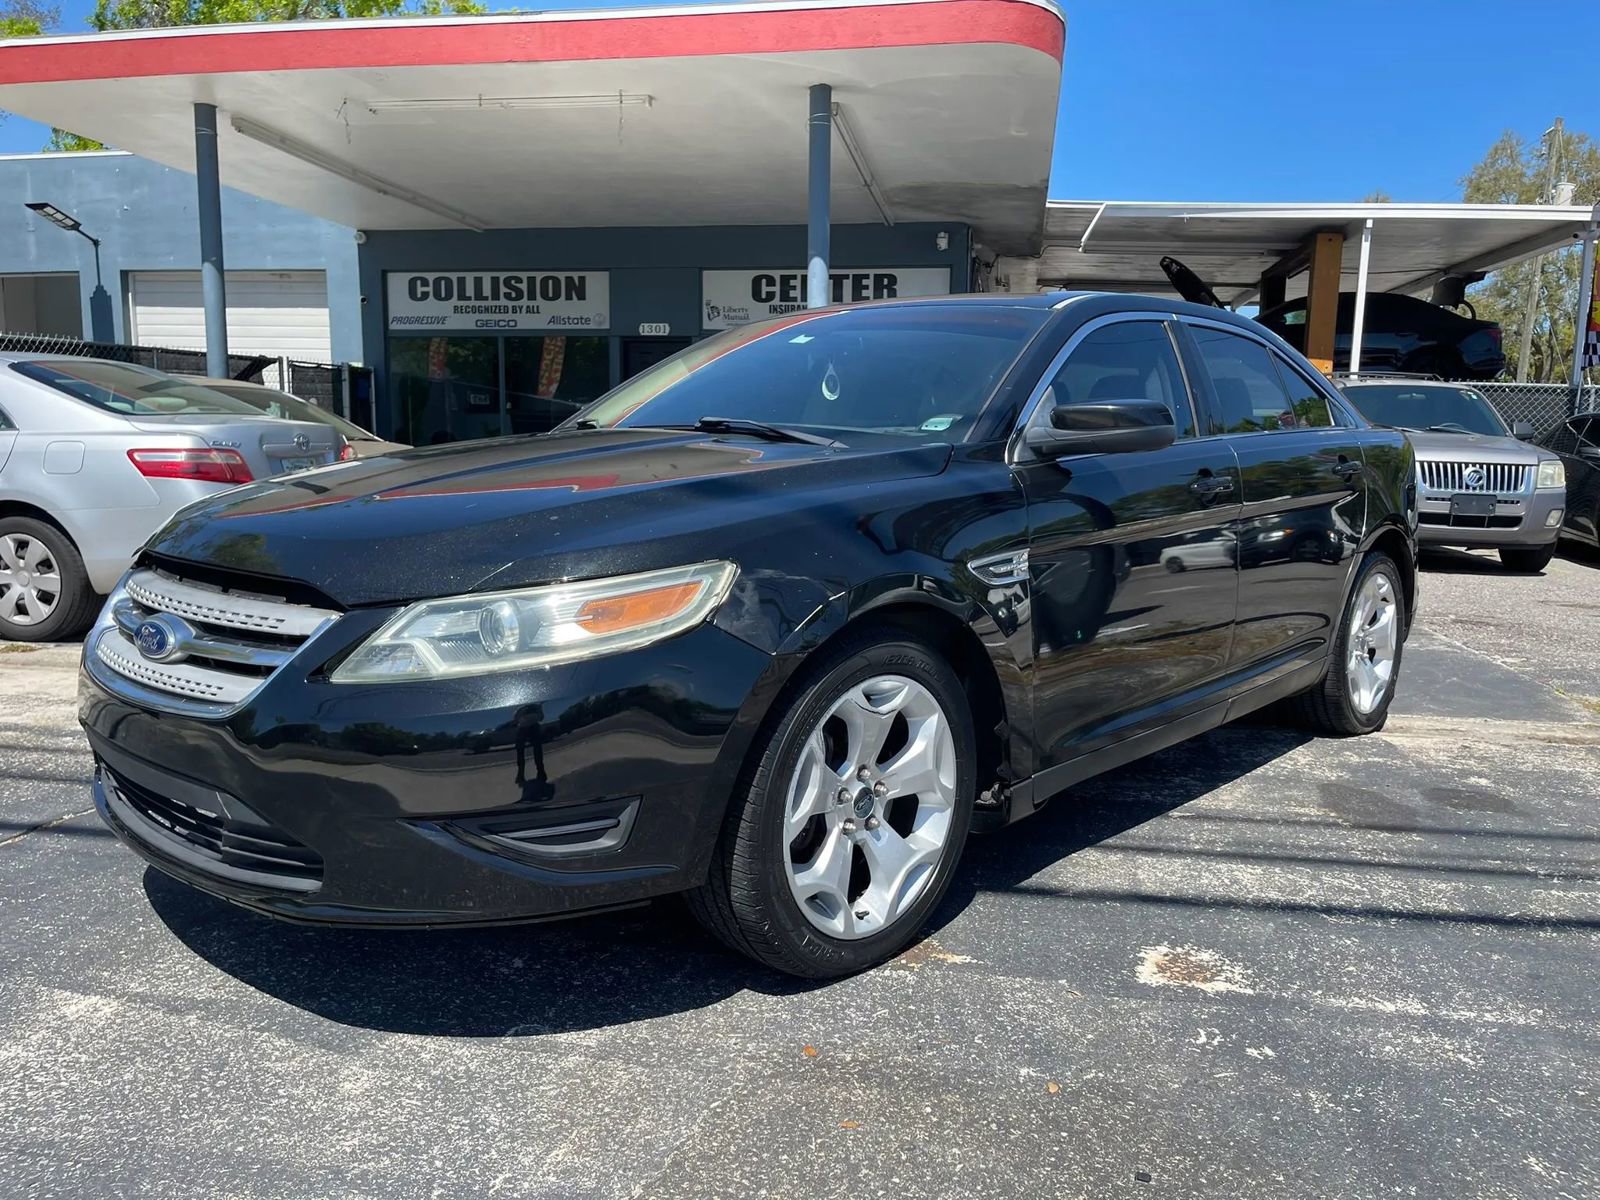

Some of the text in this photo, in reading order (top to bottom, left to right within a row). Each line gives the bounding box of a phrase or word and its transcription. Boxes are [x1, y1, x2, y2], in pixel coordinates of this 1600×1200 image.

[408, 275, 587, 302] COLLISION
[453, 304, 541, 315] RECOGNIZED BY ALL
[722, 304, 749, 313] Liberty
[390, 315, 448, 325] PROGRESSIVE
[547, 314, 592, 326] Allstate
[722, 312, 750, 321] Mutual
[475, 318, 518, 328] GEICO
[640, 324, 668, 335] 1301
[137, 625, 161, 650] Ford
